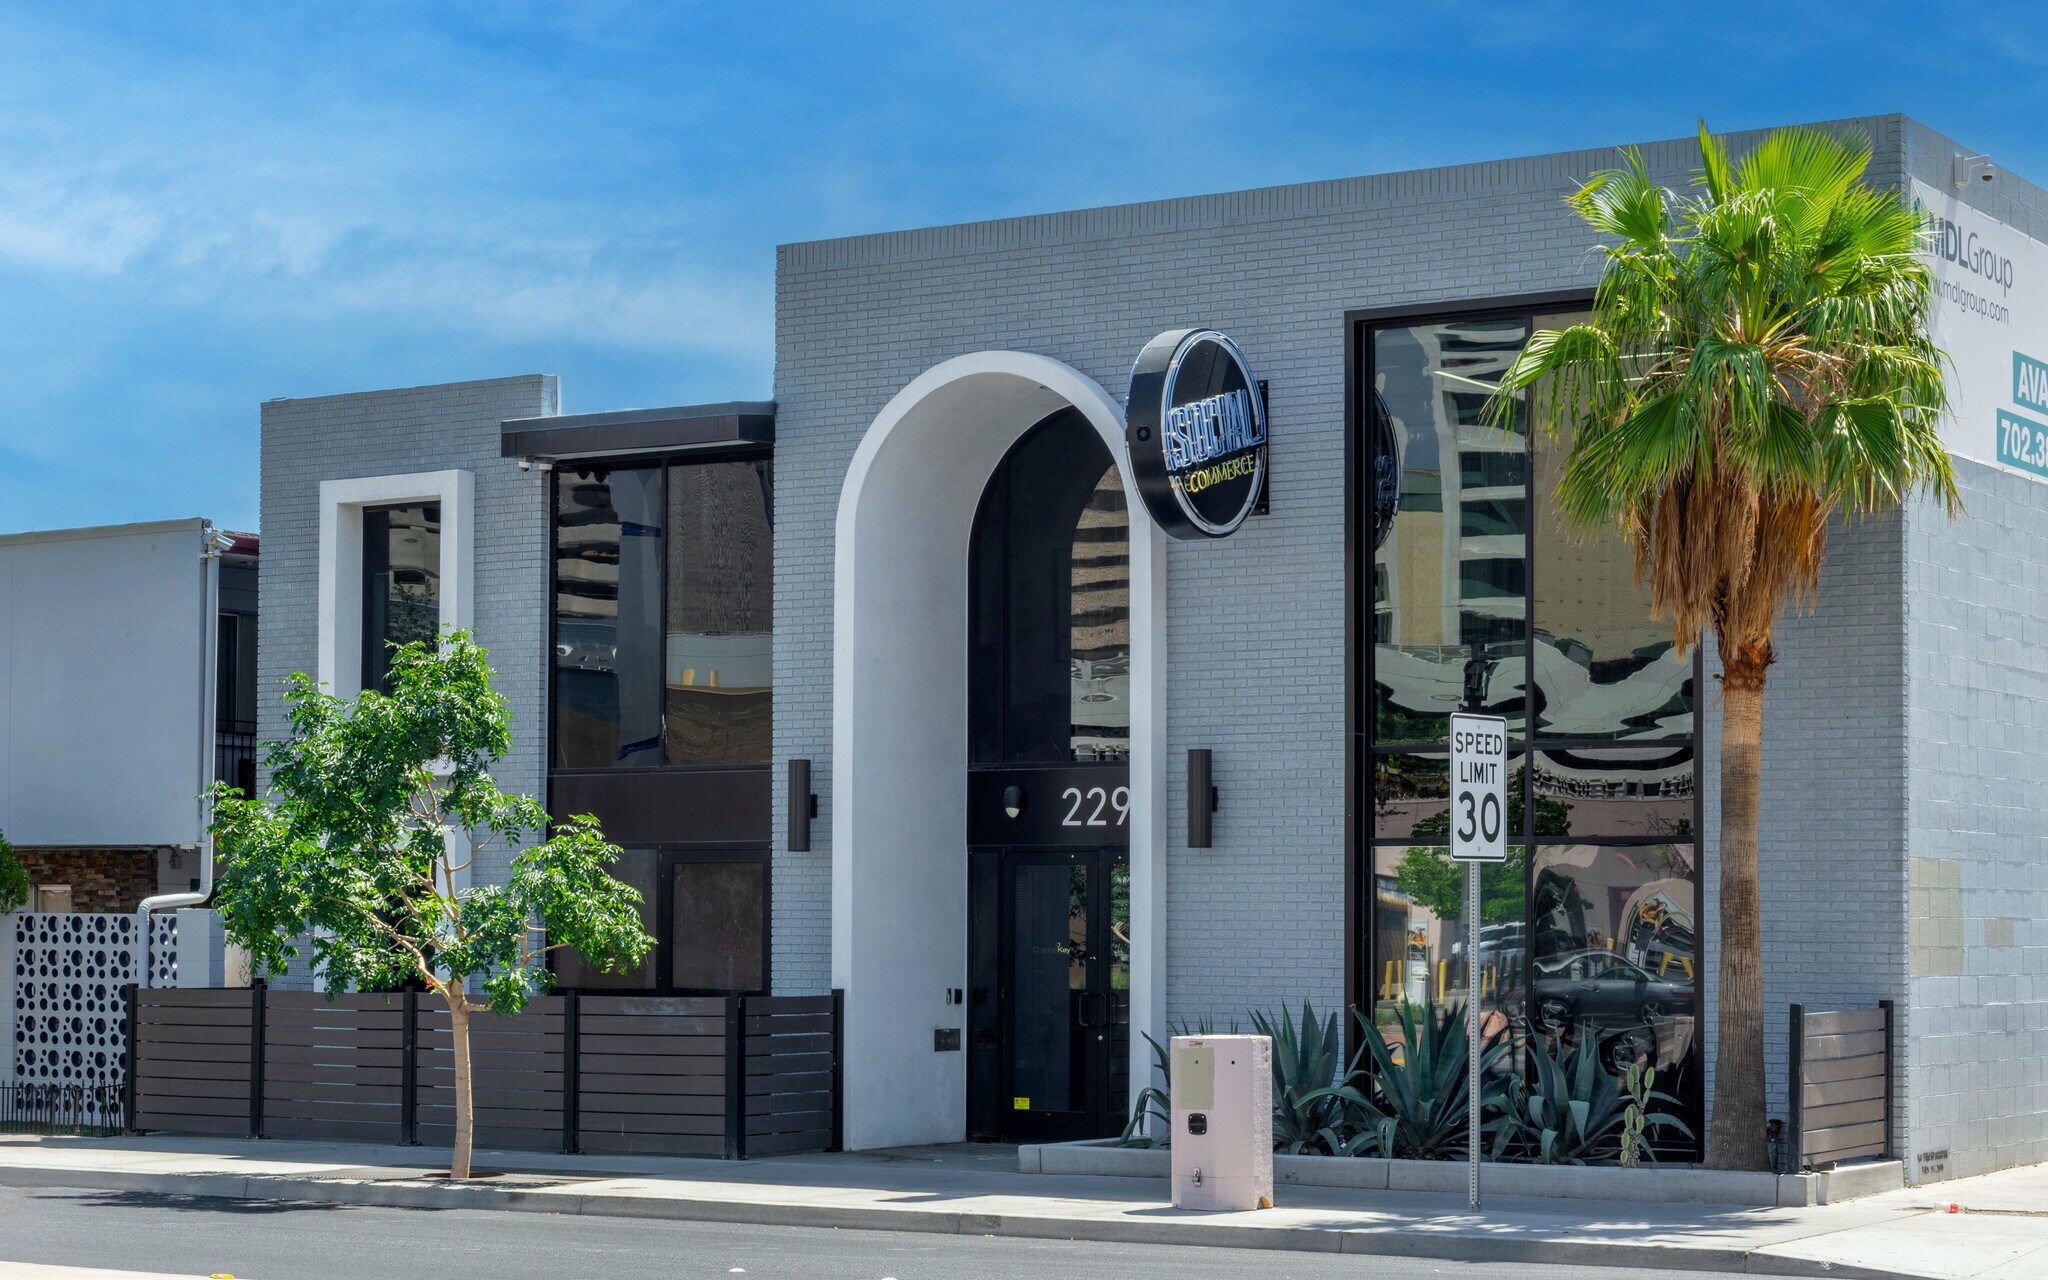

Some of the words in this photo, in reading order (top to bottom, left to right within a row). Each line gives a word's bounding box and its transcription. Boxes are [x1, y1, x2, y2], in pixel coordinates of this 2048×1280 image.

[1929, 211, 2013, 298] MDLGroup
[1167, 389, 1266, 471] SOCIAL
[2001, 418, 2048, 469] 702.3
[1188, 454, 1255, 493] COMMERCE
[1455, 731, 1503, 756] SPEED
[1460, 761, 1497, 785] LIMIT
[1061, 786, 1131, 826] 229
[1457, 790, 1501, 843] 30
